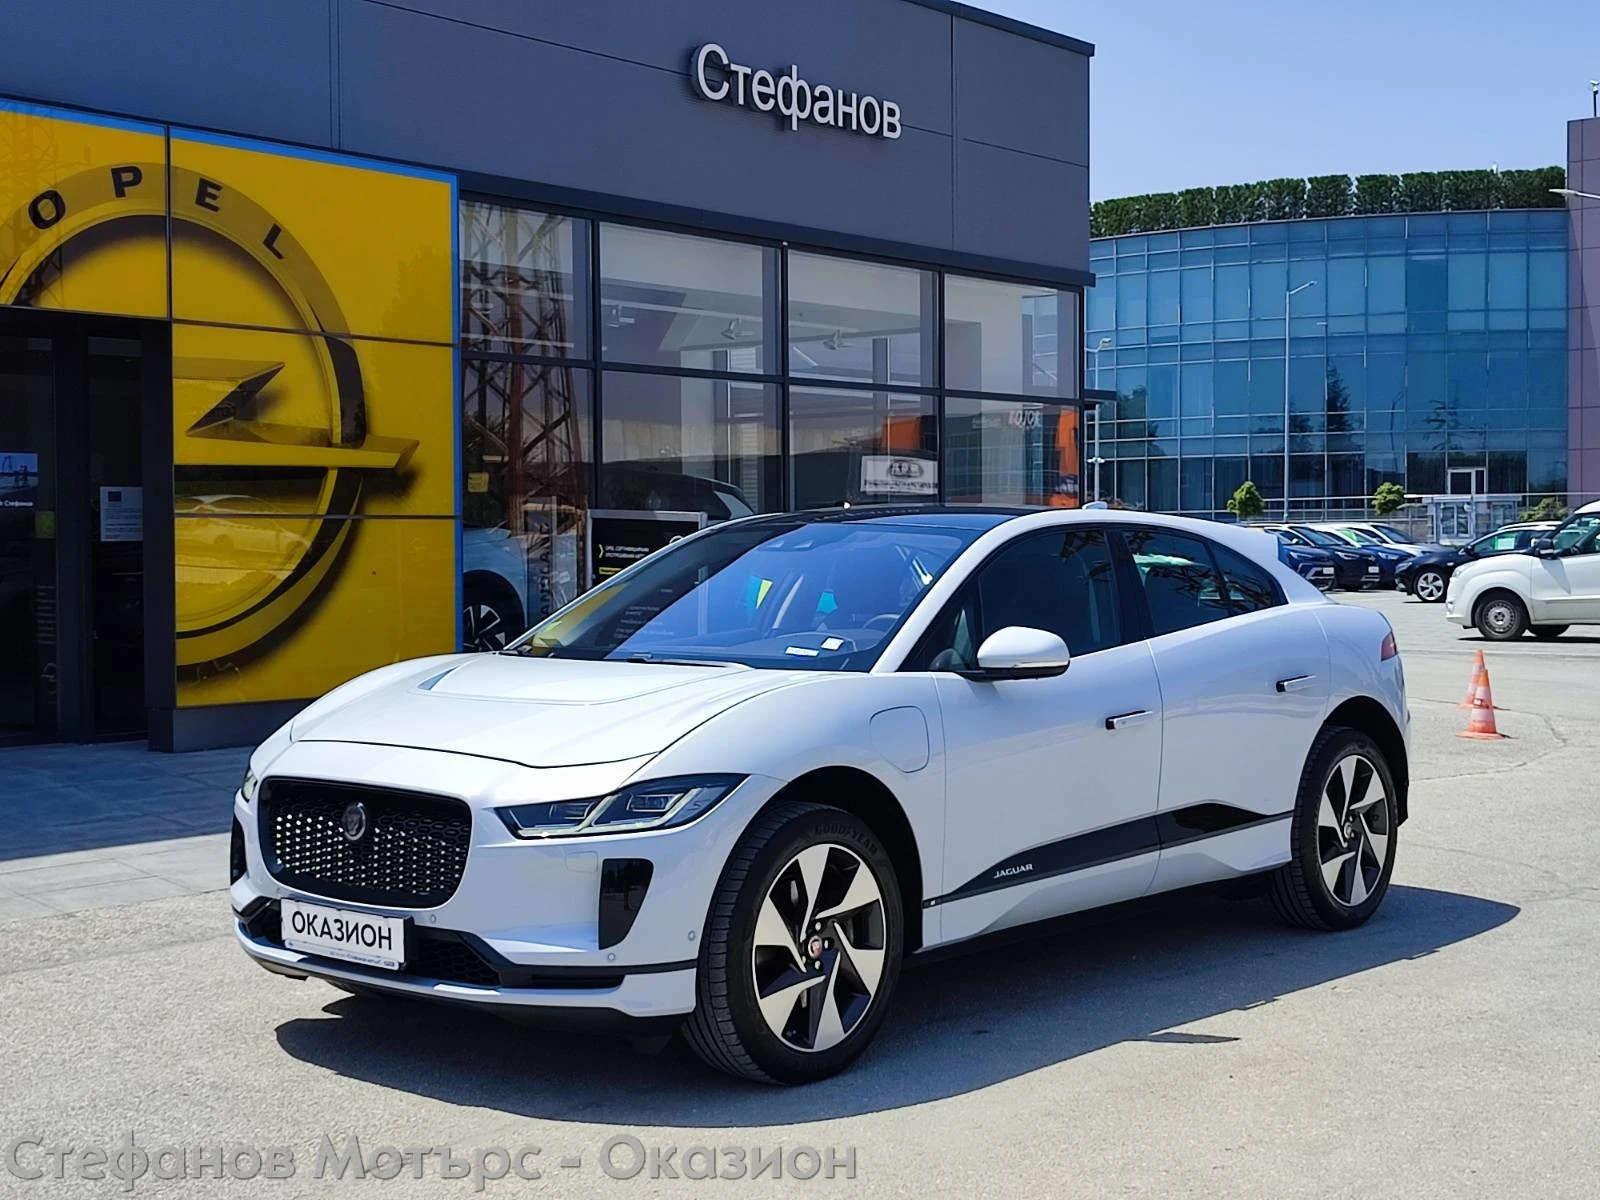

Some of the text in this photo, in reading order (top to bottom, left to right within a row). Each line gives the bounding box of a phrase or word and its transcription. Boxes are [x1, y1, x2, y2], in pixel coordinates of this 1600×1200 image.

[696, 43, 902, 139] Стефанов
[28, 165, 285, 260] OPEL
[993, 863, 1034, 879] JAGUAR
[292, 910, 392, 951] ОКАЗИОН
